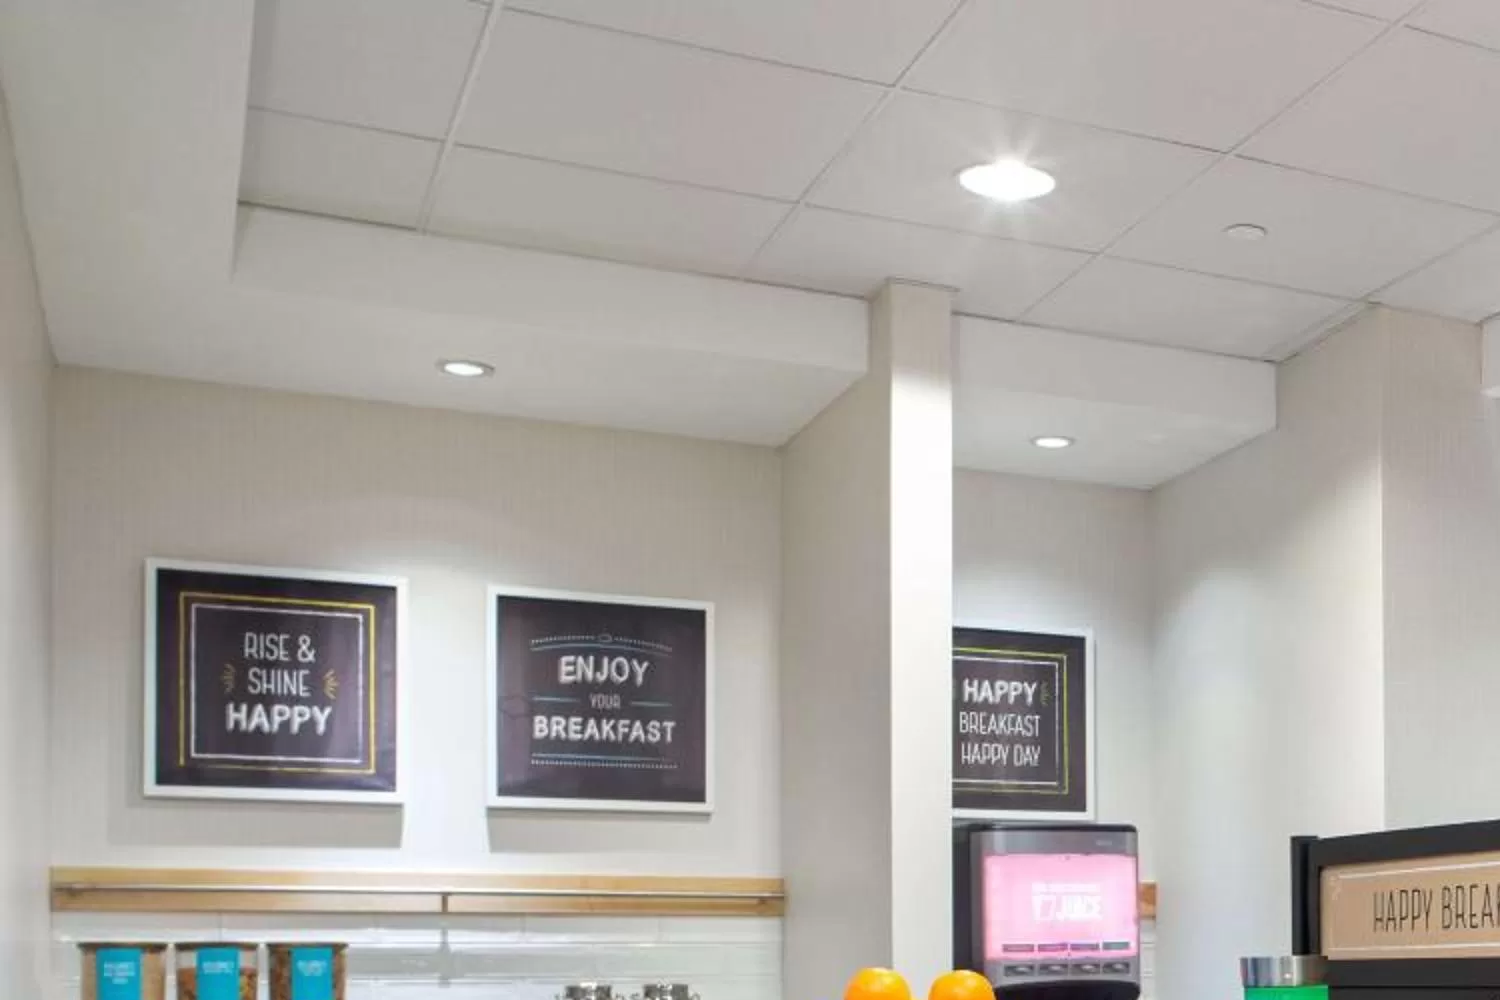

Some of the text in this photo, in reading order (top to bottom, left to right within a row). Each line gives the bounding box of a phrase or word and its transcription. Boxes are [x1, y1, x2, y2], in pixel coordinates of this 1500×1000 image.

[243, 631, 316, 663] RISE &
[247, 666, 312, 697] SHINE
[558, 654, 650, 687] ENJOY
[589, 693, 622, 710] YOUR
[963, 677, 1037, 706] HAPPY
[225, 701, 332, 736] HAPPY
[532, 714, 677, 744] BREAKFAST
[959, 711, 1041, 737] BREAKFAST
[961, 742, 1041, 767] HAPPY DAY
[1373, 886, 1433, 933] HAPPY
